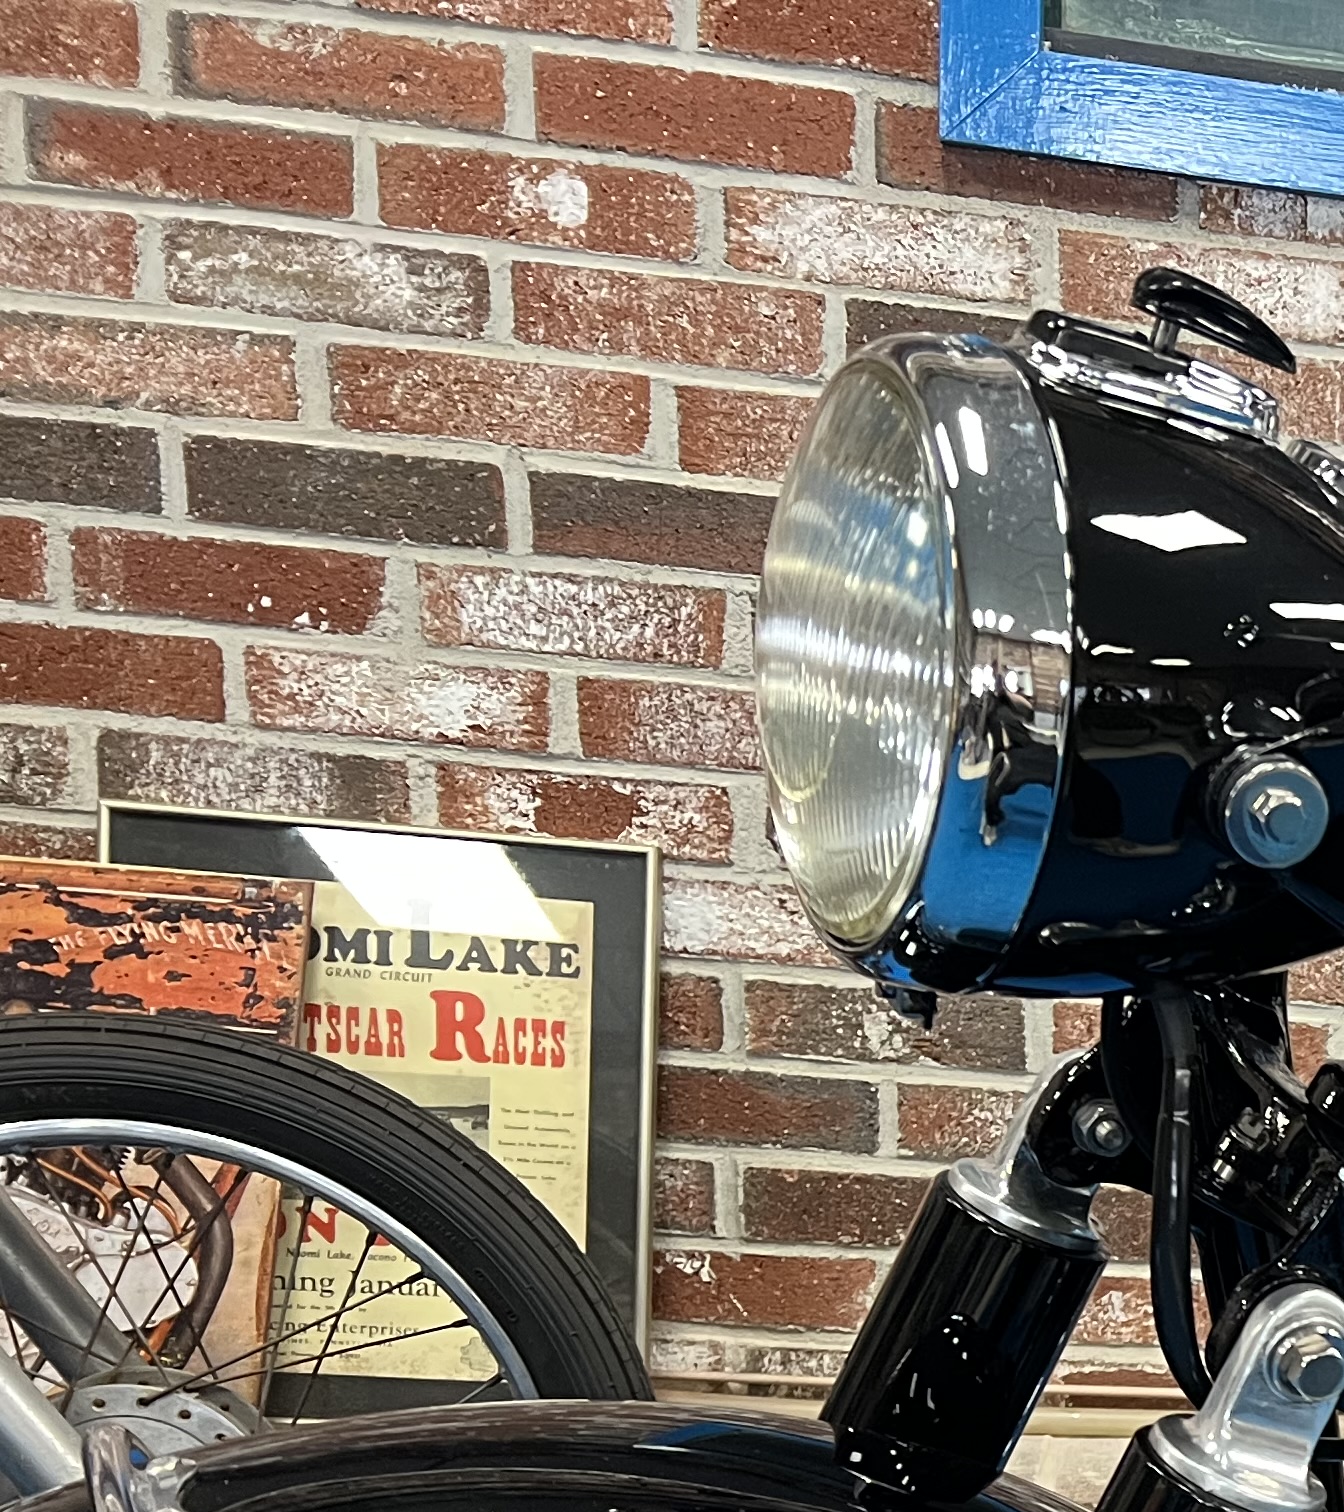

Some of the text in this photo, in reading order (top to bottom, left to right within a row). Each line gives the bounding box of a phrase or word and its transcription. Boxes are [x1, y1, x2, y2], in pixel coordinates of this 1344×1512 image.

[325, 966, 433, 984] GRAND CIRCUIT
[404, 899, 582, 979] LAKE
[428, 989, 567, 1069] RACES
